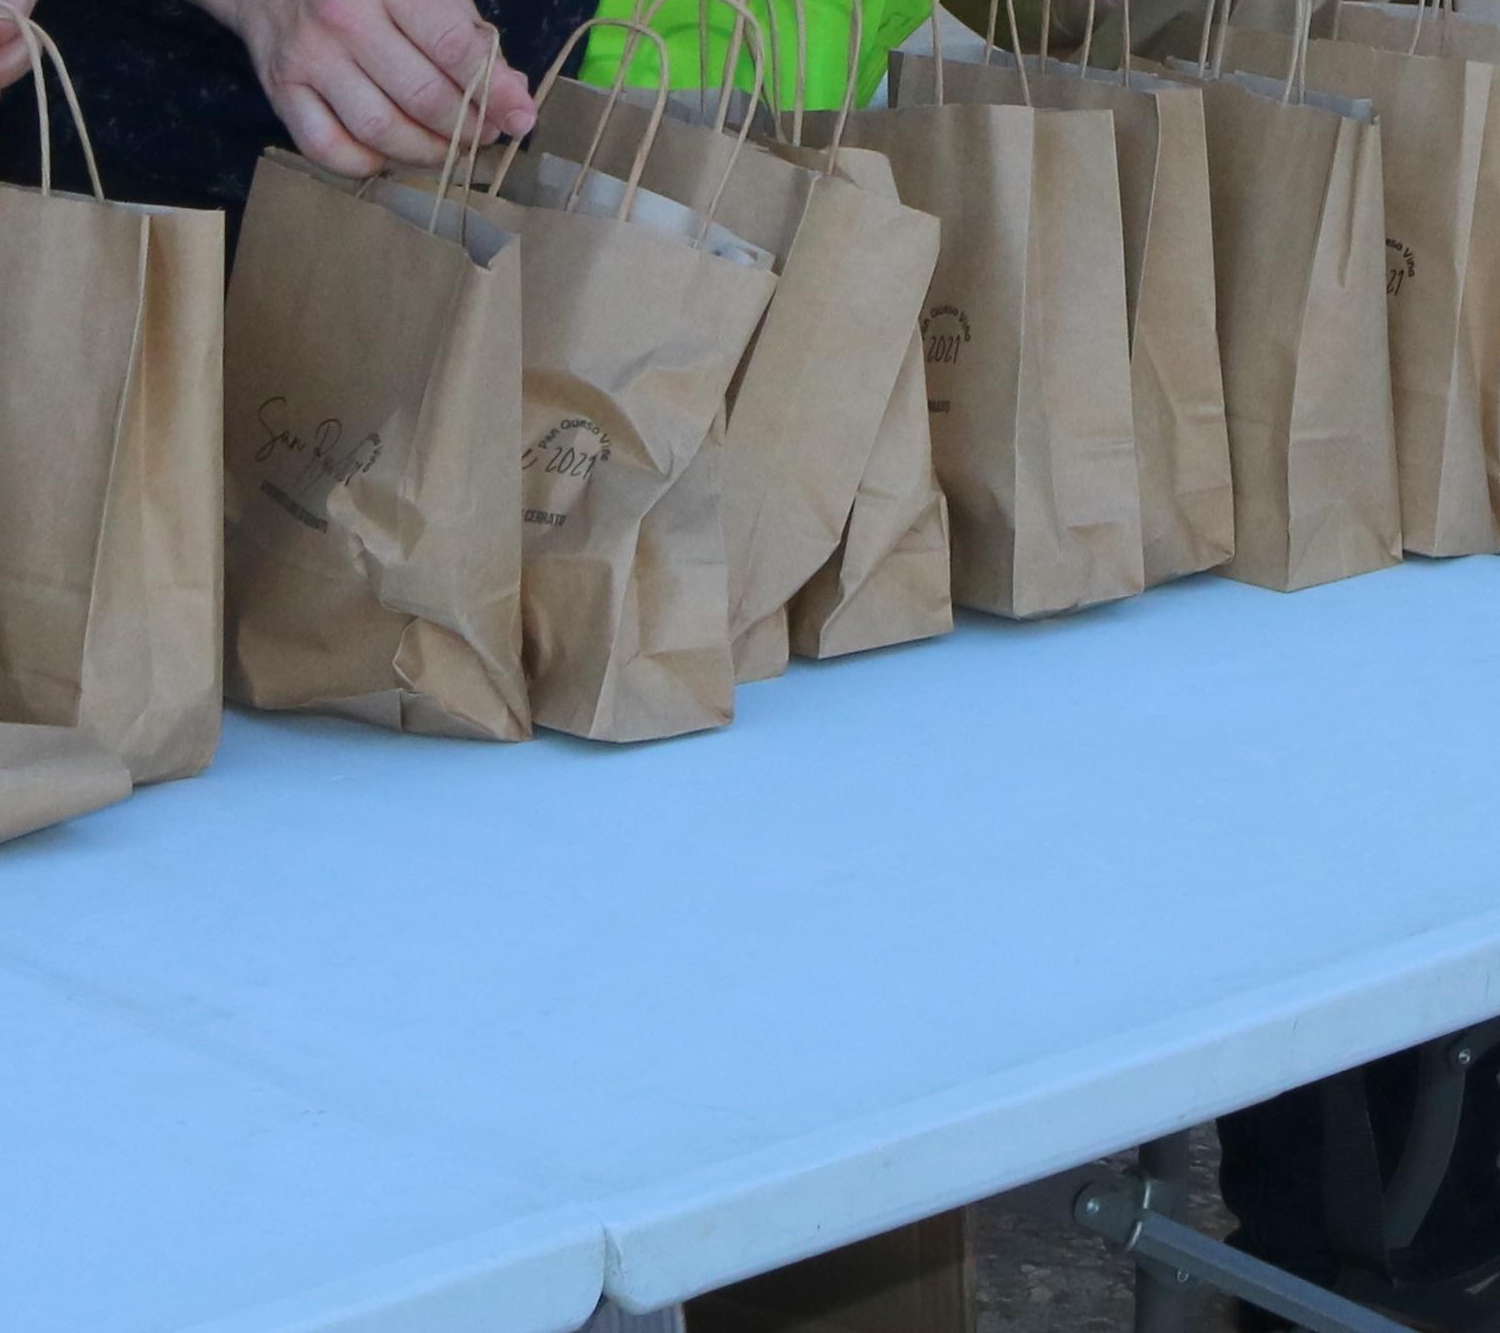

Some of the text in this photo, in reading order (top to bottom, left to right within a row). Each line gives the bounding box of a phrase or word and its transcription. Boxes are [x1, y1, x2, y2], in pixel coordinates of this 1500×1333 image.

[1386, 269, 1404, 296] 21
[927, 335, 960, 365] 2021
[255, 396, 306, 462] San
[538, 428, 560, 449] Pan
[561, 419, 600, 435] Queso
[545, 447, 597, 480] 2021
